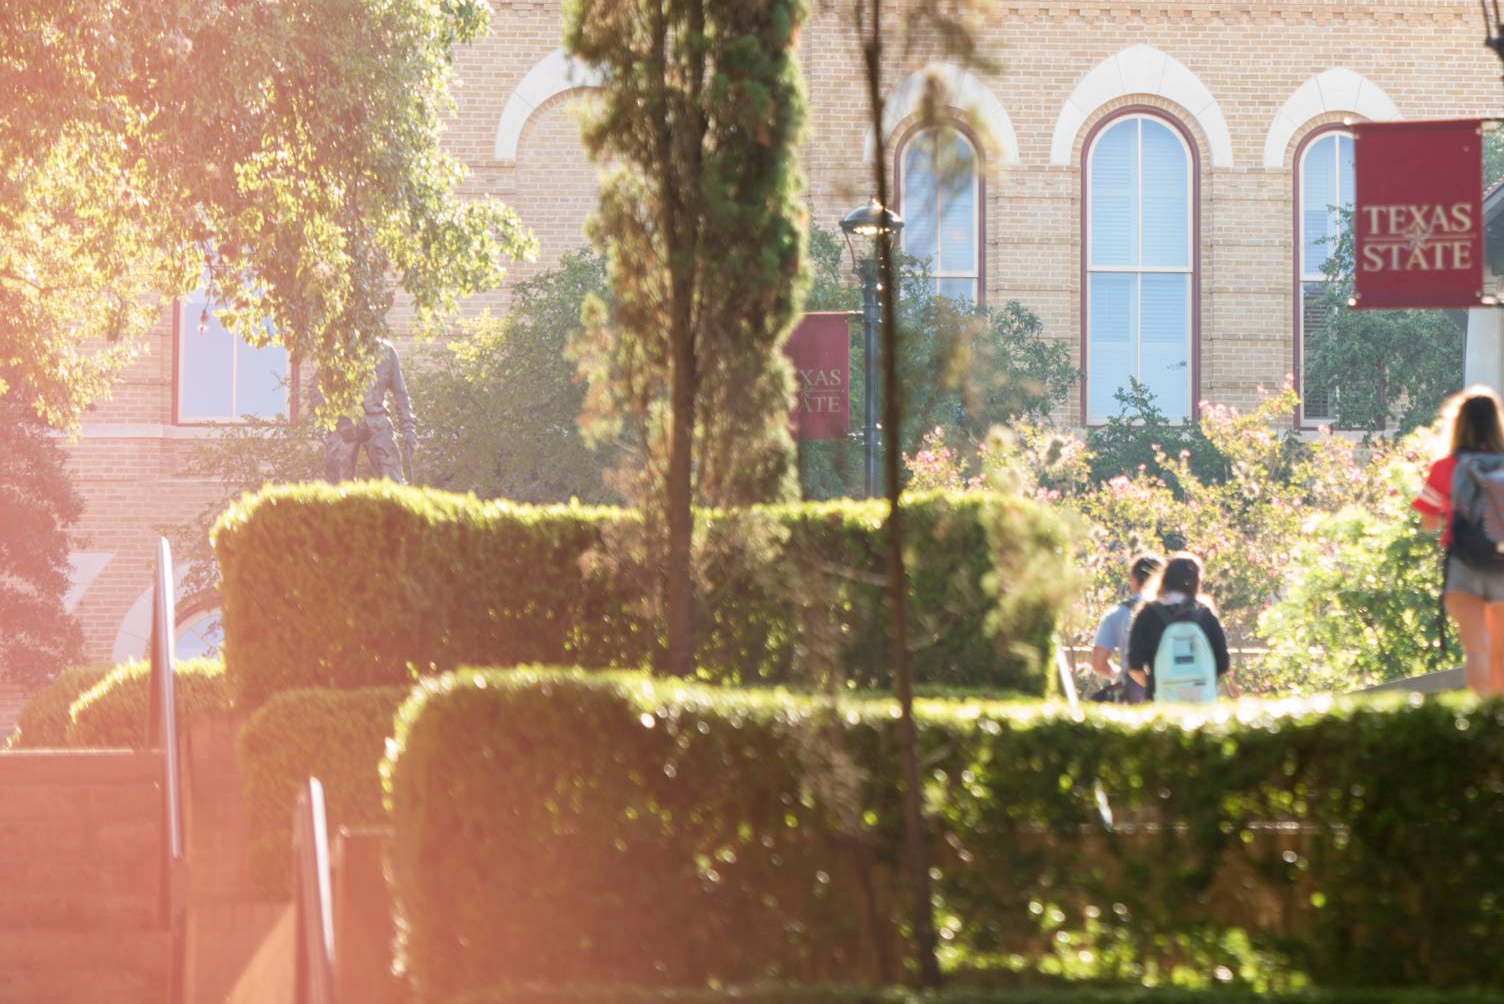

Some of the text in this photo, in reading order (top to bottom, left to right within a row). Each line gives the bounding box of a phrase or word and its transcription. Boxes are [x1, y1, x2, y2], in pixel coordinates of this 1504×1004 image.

[1362, 203, 1473, 235] TEXAS
[1362, 242, 1473, 272] STATE
[799, 368, 841, 386] XAS
[799, 395, 841, 413] ATE
